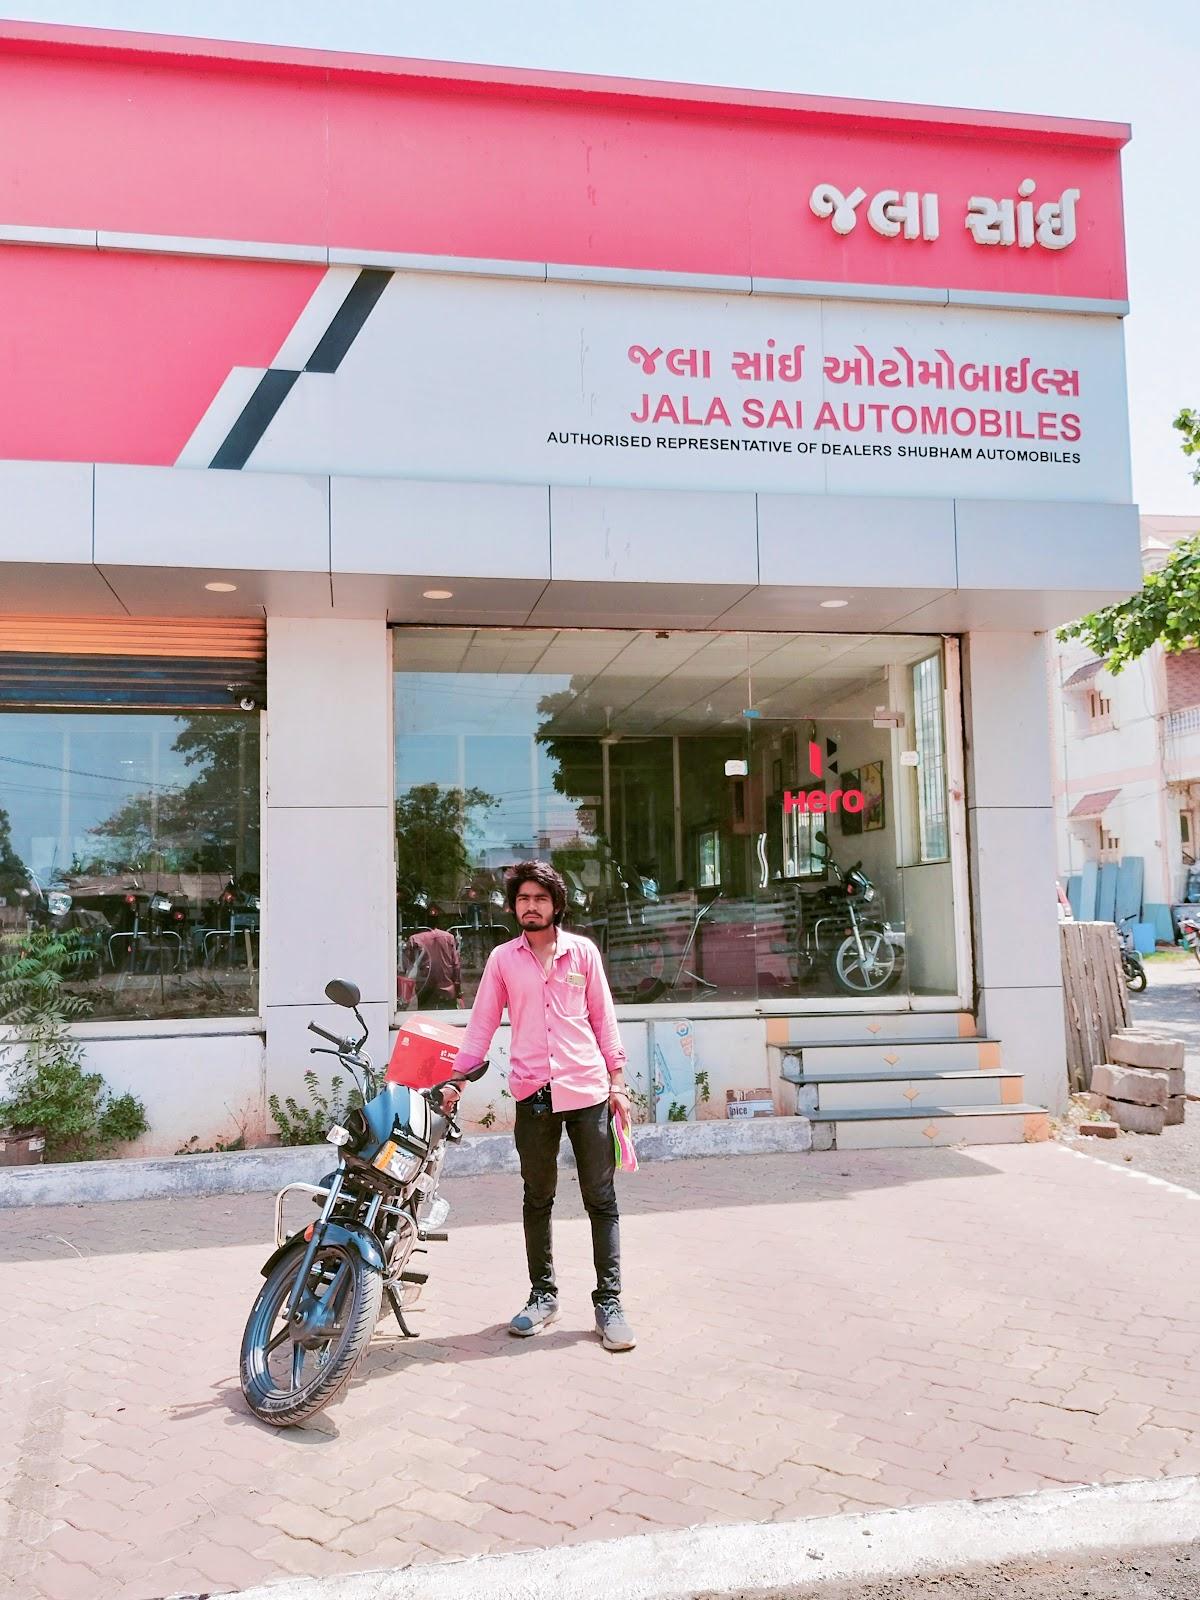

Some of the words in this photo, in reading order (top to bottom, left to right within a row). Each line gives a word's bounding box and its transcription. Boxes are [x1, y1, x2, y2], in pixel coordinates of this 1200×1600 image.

[809, 183, 940, 241] જલા
[965, 178, 1080, 250] સાંઈ
[627, 344, 712, 379] જલા
[731, 339, 806, 383] સાંઈ
[823, 345, 1080, 397] ઓટોમોબાઈલ્સ
[630, 394, 732, 426] JALA
[742, 398, 804, 429] SAI
[814, 401, 1082, 442] AUTOMOBILES
[546, 431, 652, 448] AUTHORISED
[656, 436, 793, 454] REPRESENTATIVE
[797, 442, 818, 454] OF
[821, 443, 893, 457] DEALERS
[897, 445, 973, 460] SHUBHAM
[975, 448, 1081, 464] AUTOMOBILES
